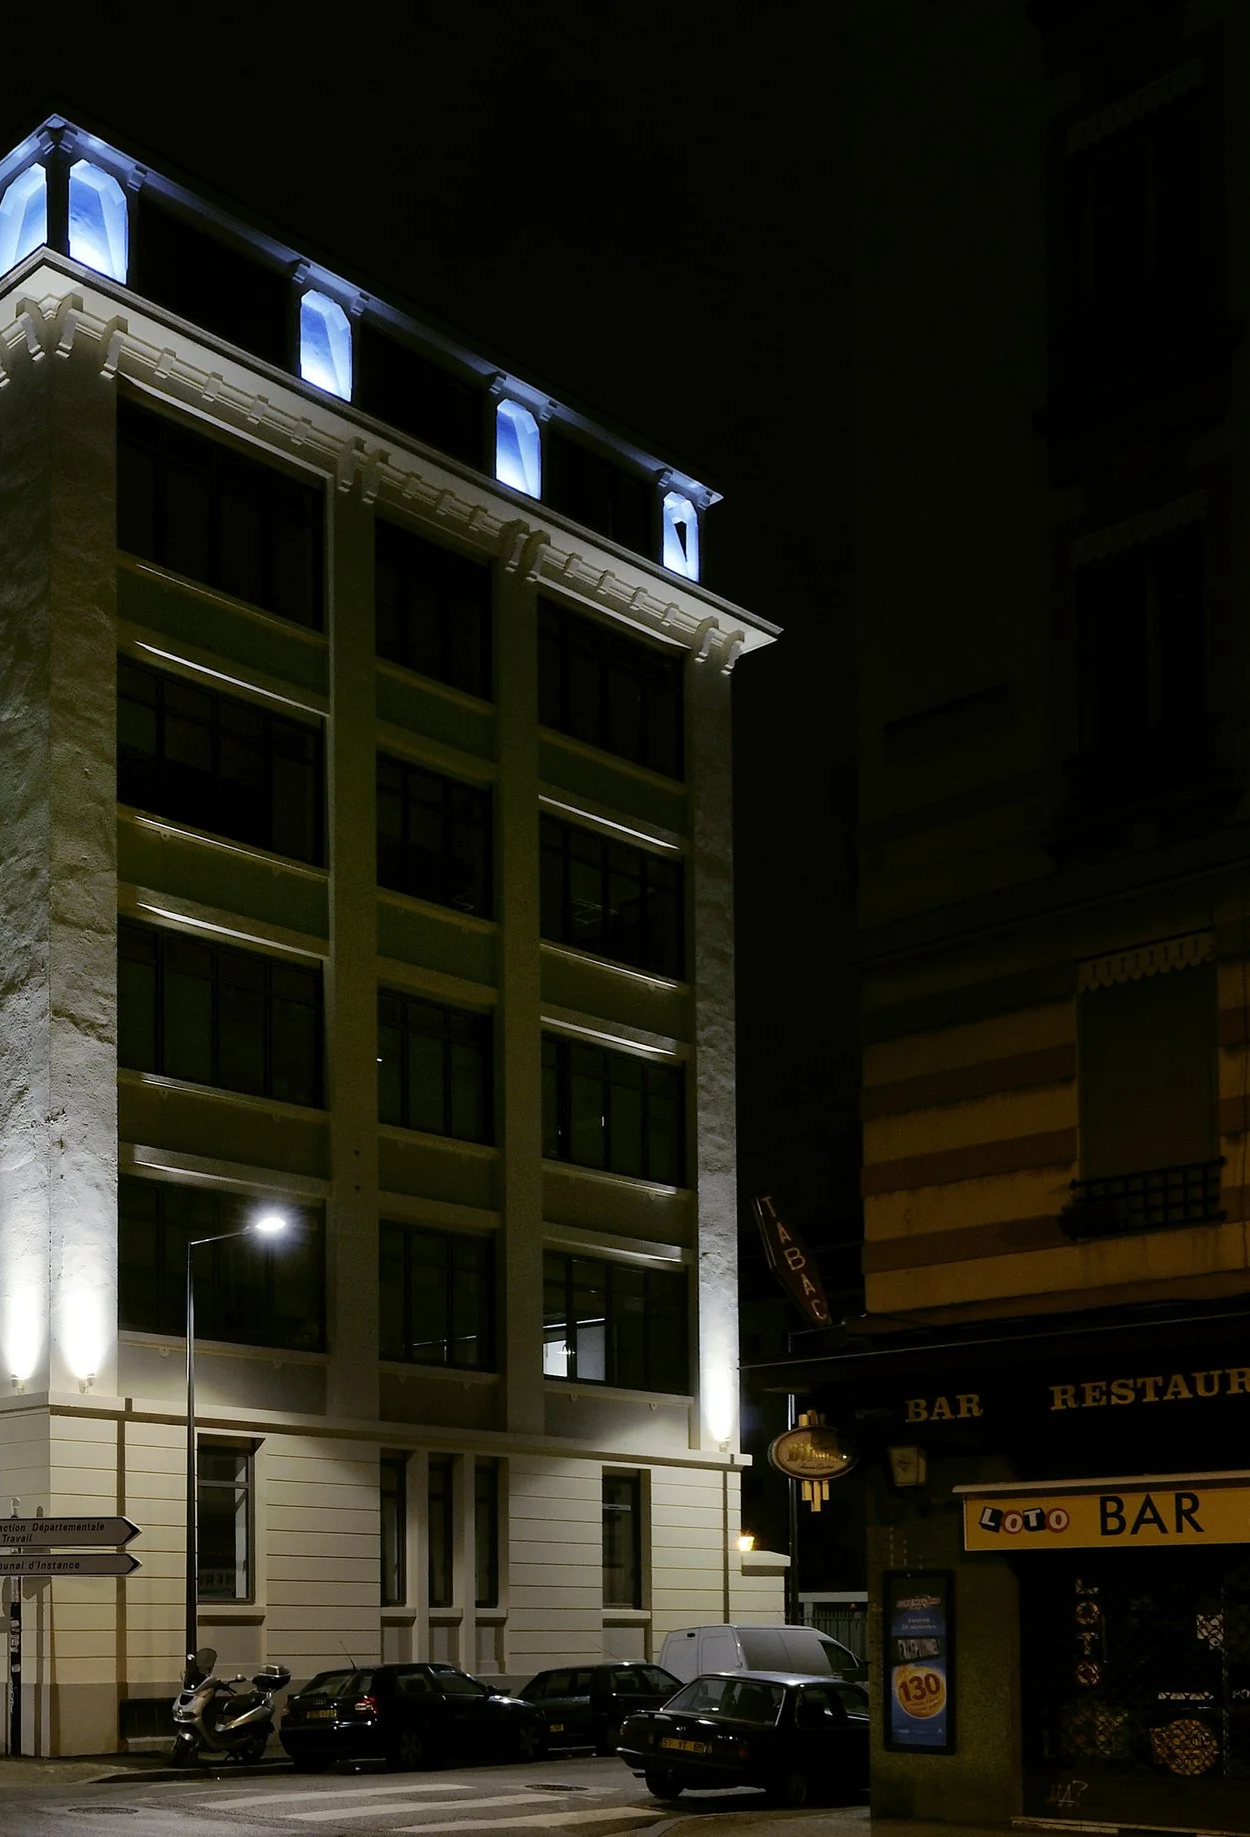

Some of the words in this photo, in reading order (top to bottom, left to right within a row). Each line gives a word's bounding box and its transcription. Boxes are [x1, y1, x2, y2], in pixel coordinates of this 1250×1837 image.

[759, 1193, 828, 1321] TABAC
[904, 1393, 984, 1423] BAR
[31, 1521, 106, 1533] Départementale
[979, 1506, 1070, 1534] LOTO
[1100, 1492, 1204, 1536] BAR
[2, 1533, 33, 1543] Travail
[28, 1560, 81, 1570] d'Instance
[899, 1673, 941, 1702] 130
